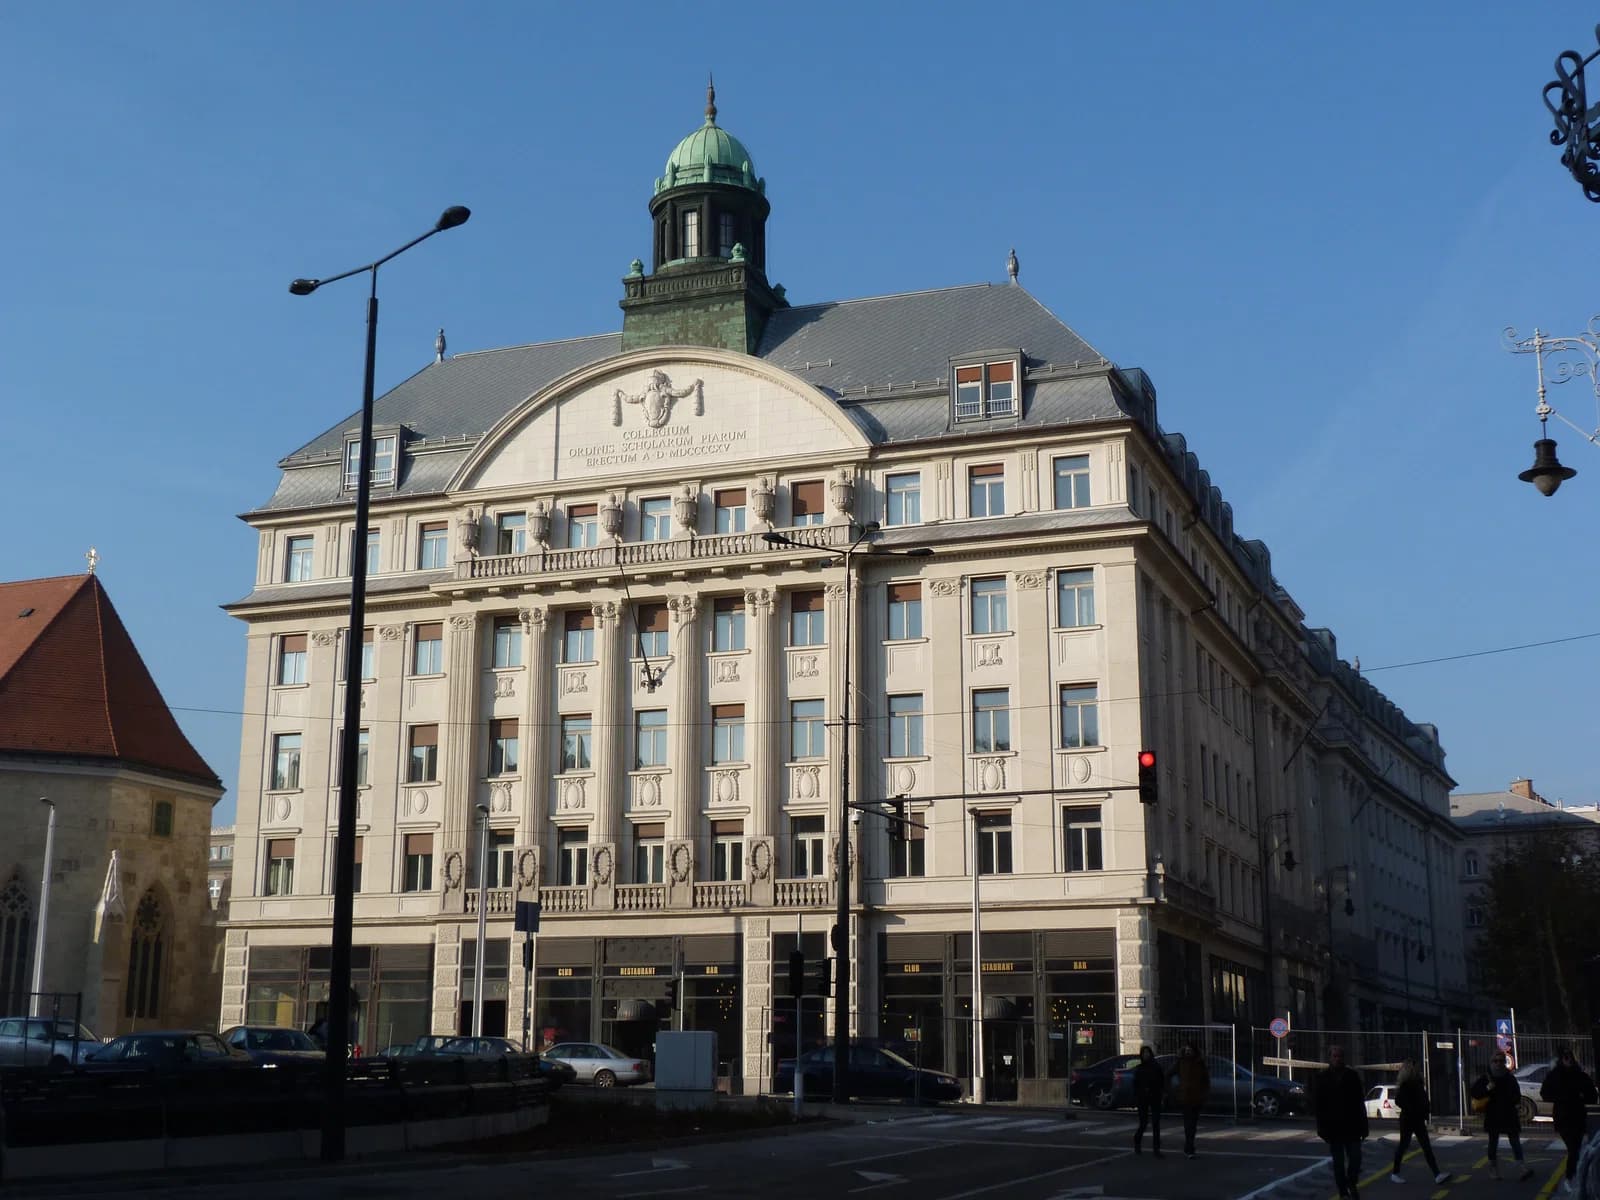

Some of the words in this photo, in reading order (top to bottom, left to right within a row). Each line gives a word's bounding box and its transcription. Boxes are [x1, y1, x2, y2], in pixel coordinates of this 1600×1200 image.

[623, 425, 690, 440] COLLEGIUM
[569, 444, 615, 458] ORDINIS
[622, 435, 693, 452] SCHOLARUM
[701, 430, 747, 444] PIARUM
[586, 453, 637, 467] ERECTUM
[904, 964, 920, 972] CLUB
[981, 962, 1014, 971] STAURANT
[1073, 961, 1087, 969] BAR
[620, 967, 655, 975] RESTAURANT
